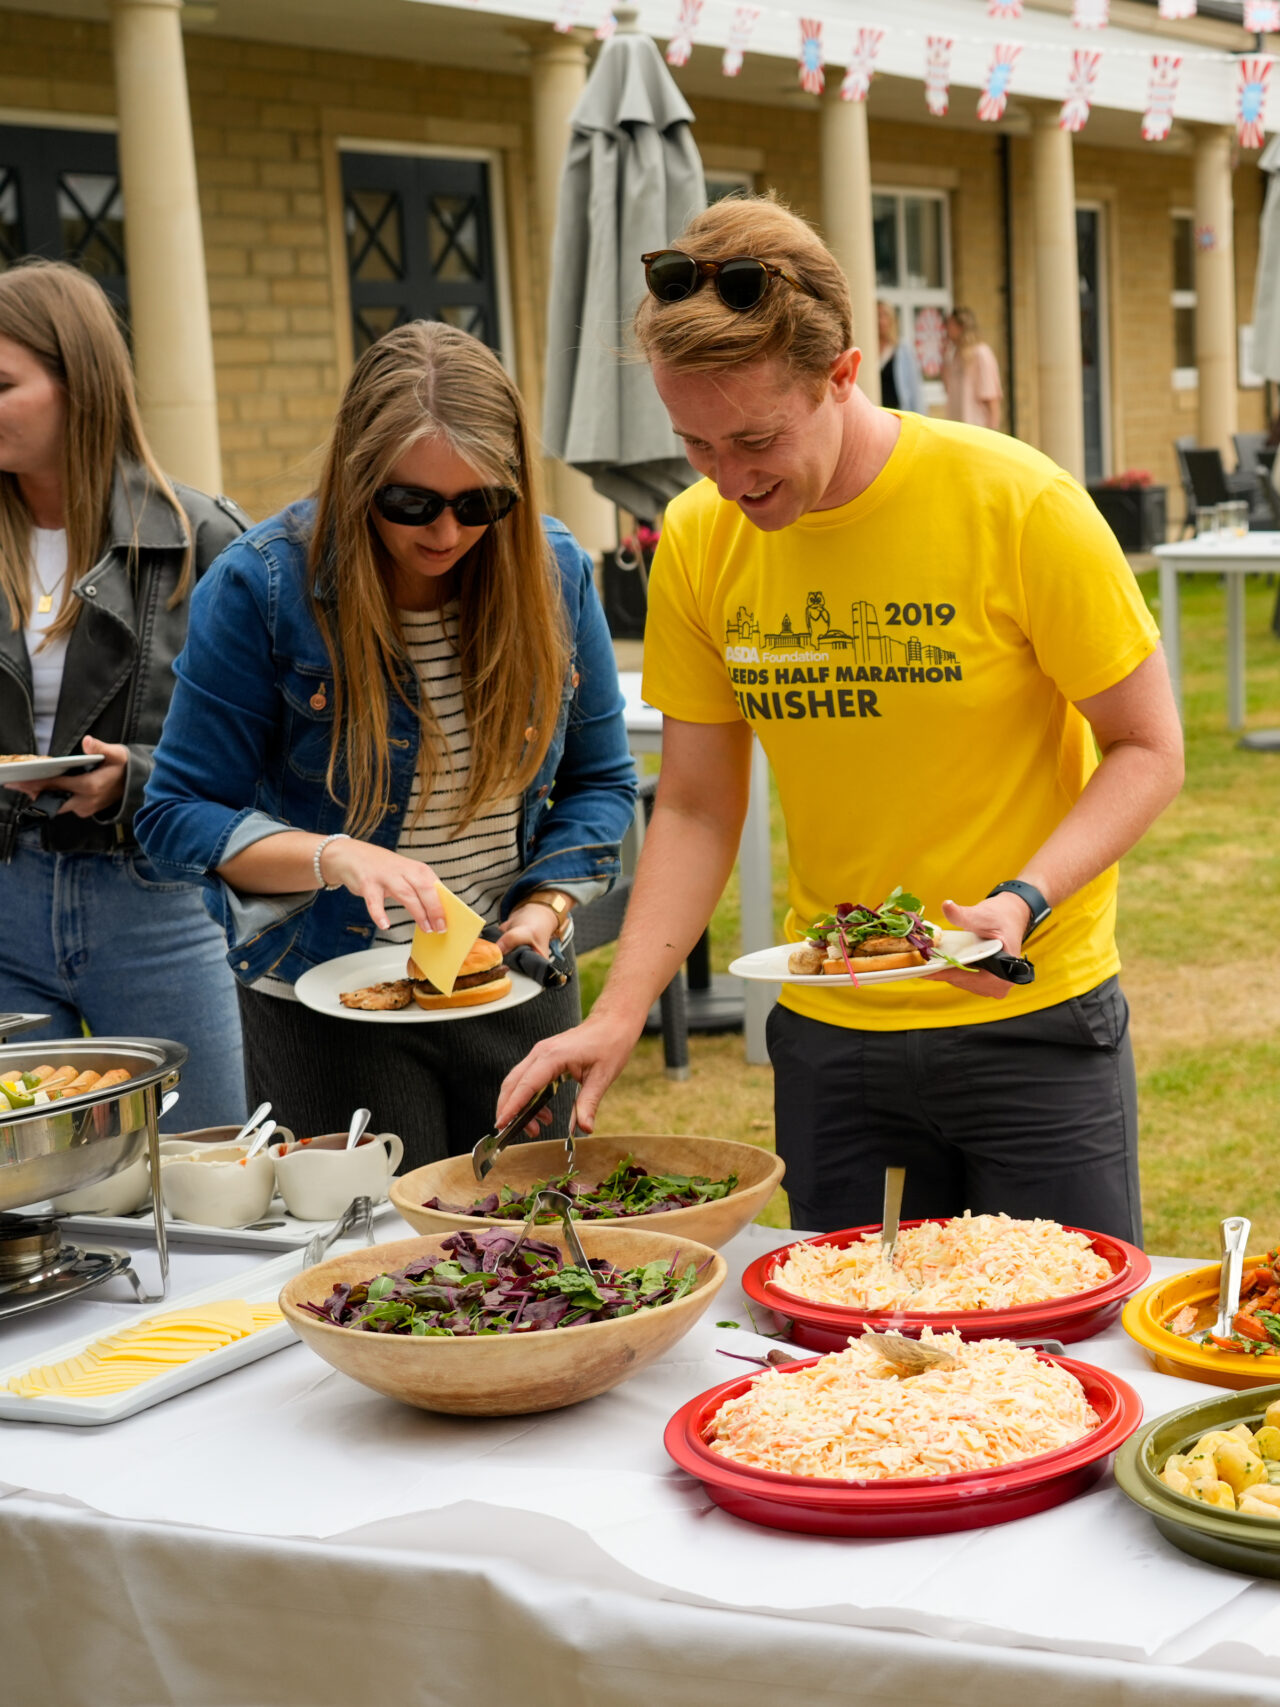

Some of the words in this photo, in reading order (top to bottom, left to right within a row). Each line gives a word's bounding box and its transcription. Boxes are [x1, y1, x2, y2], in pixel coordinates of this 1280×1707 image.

[885, 603, 956, 626] 2019
[725, 646, 760, 663] ASDA
[762, 651, 829, 663] Foundation
[775, 667, 829, 684] HALF
[836, 666, 963, 683] MARATHON
[735, 690, 882, 719] INISHER
